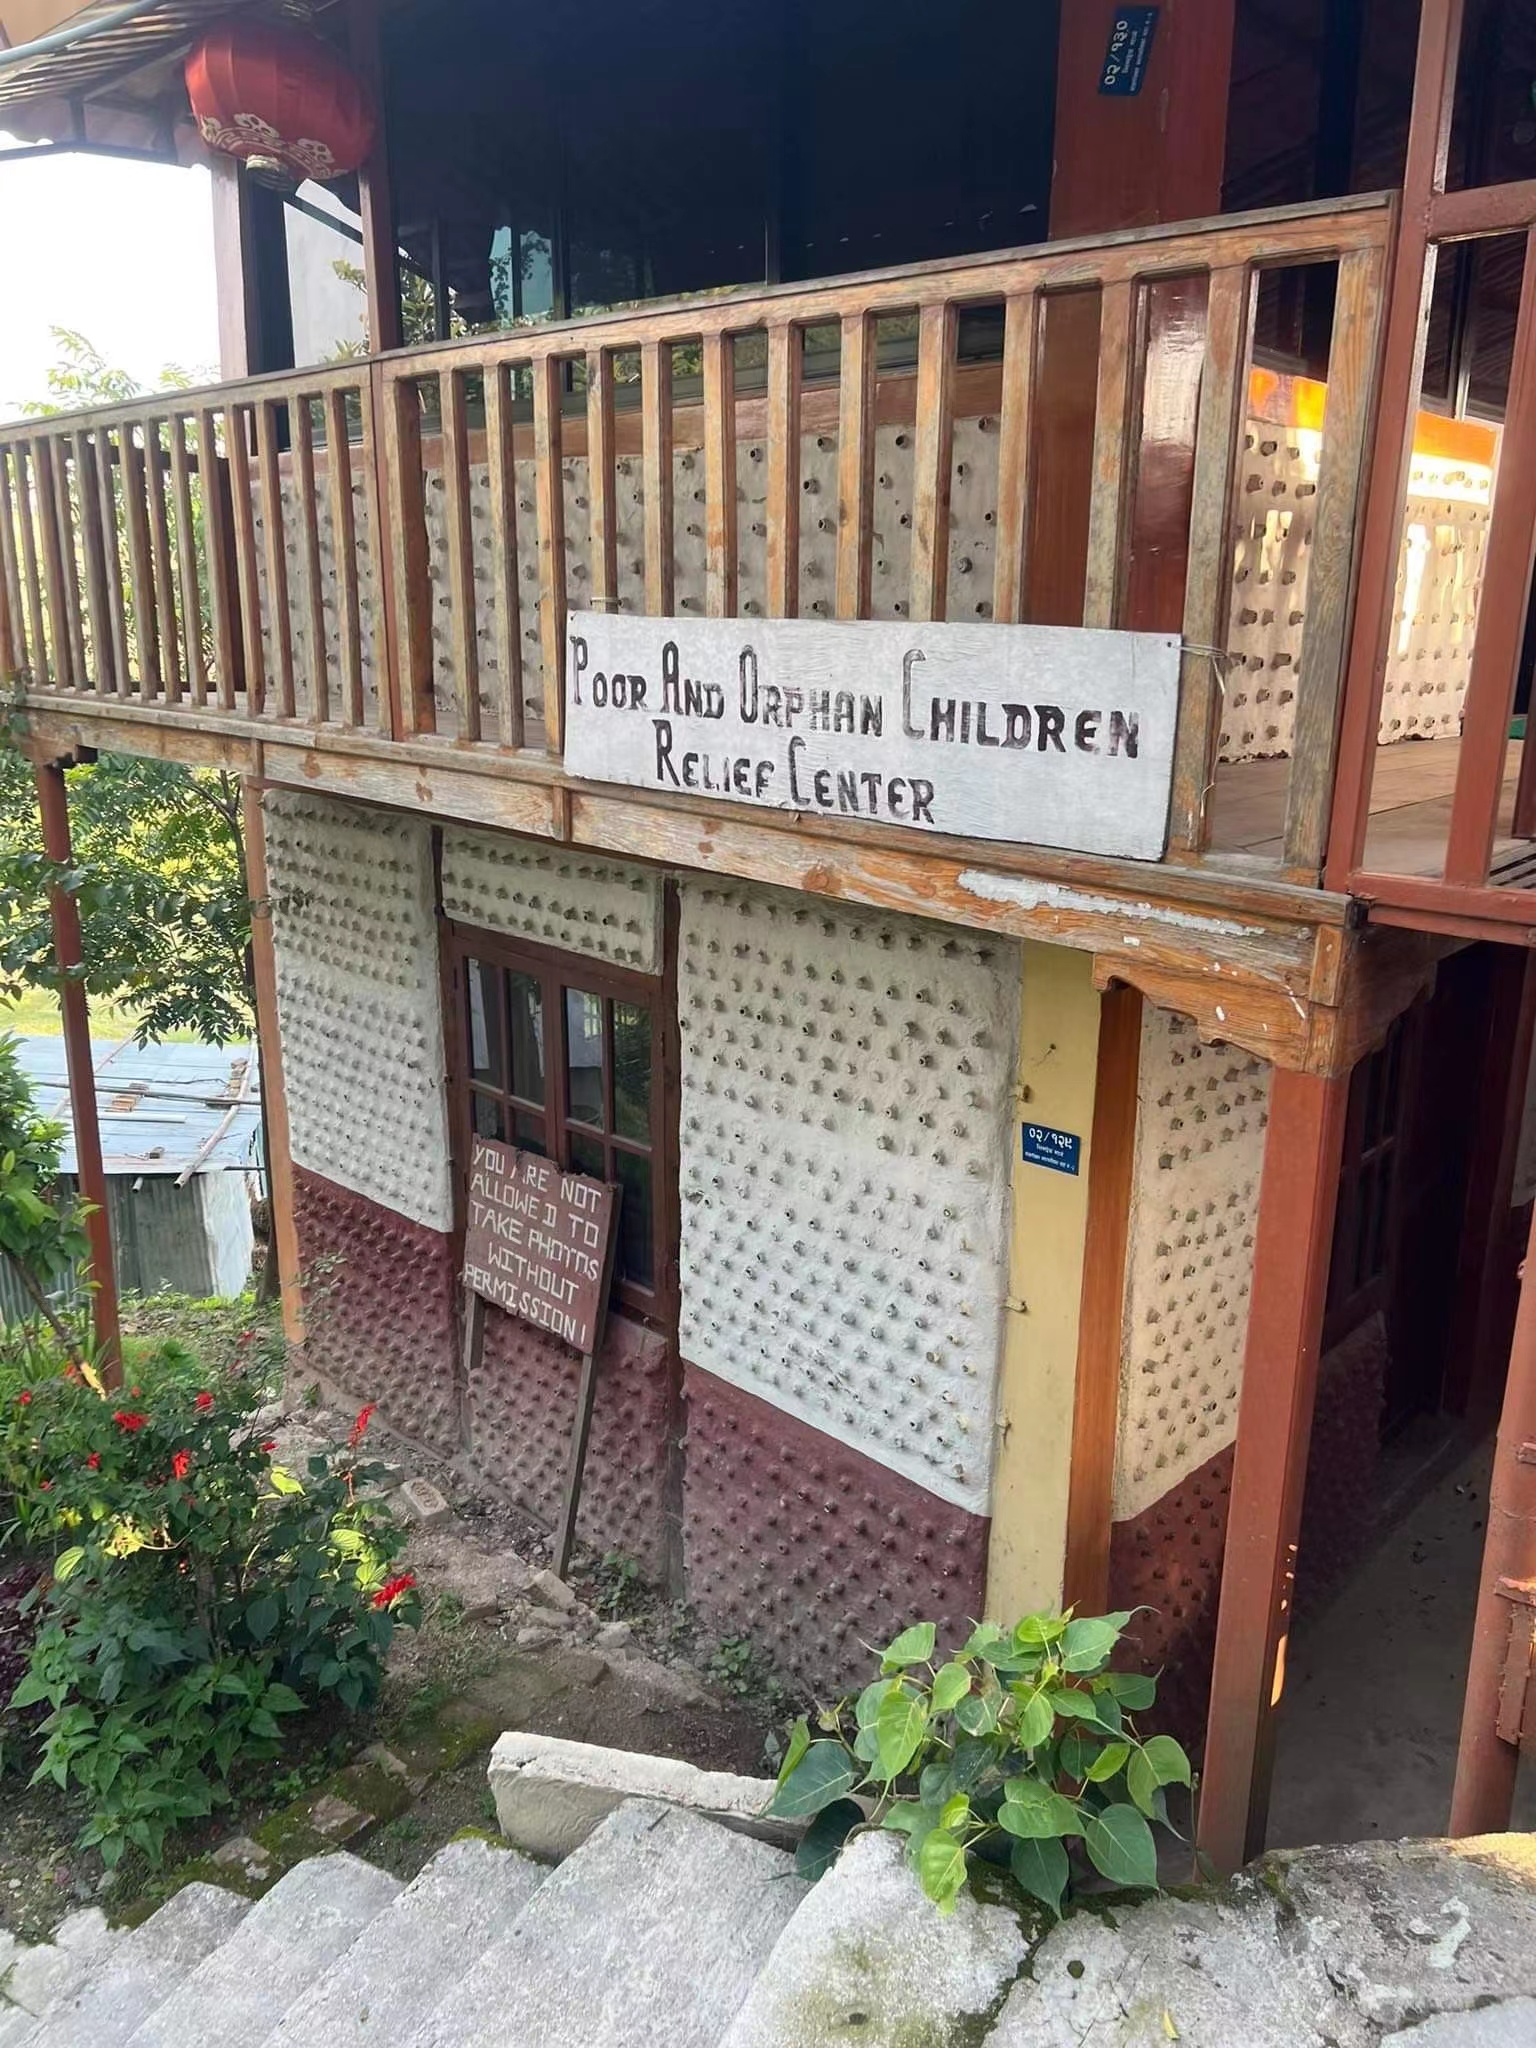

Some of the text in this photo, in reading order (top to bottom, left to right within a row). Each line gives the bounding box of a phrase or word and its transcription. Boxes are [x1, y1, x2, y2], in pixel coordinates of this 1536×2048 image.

[569, 635, 1140, 759] POOR AND ORPHAN CHILDREN
[651, 718, 935, 825] RELIEF CENTER
[470, 1172, 599, 1249] ALLOWED TO
[473, 1143, 505, 1175] YOU
[560, 1177, 602, 1214] NOT
[471, 1200, 524, 1245] TAKE
[487, 1241, 580, 1304] WITHOUT
